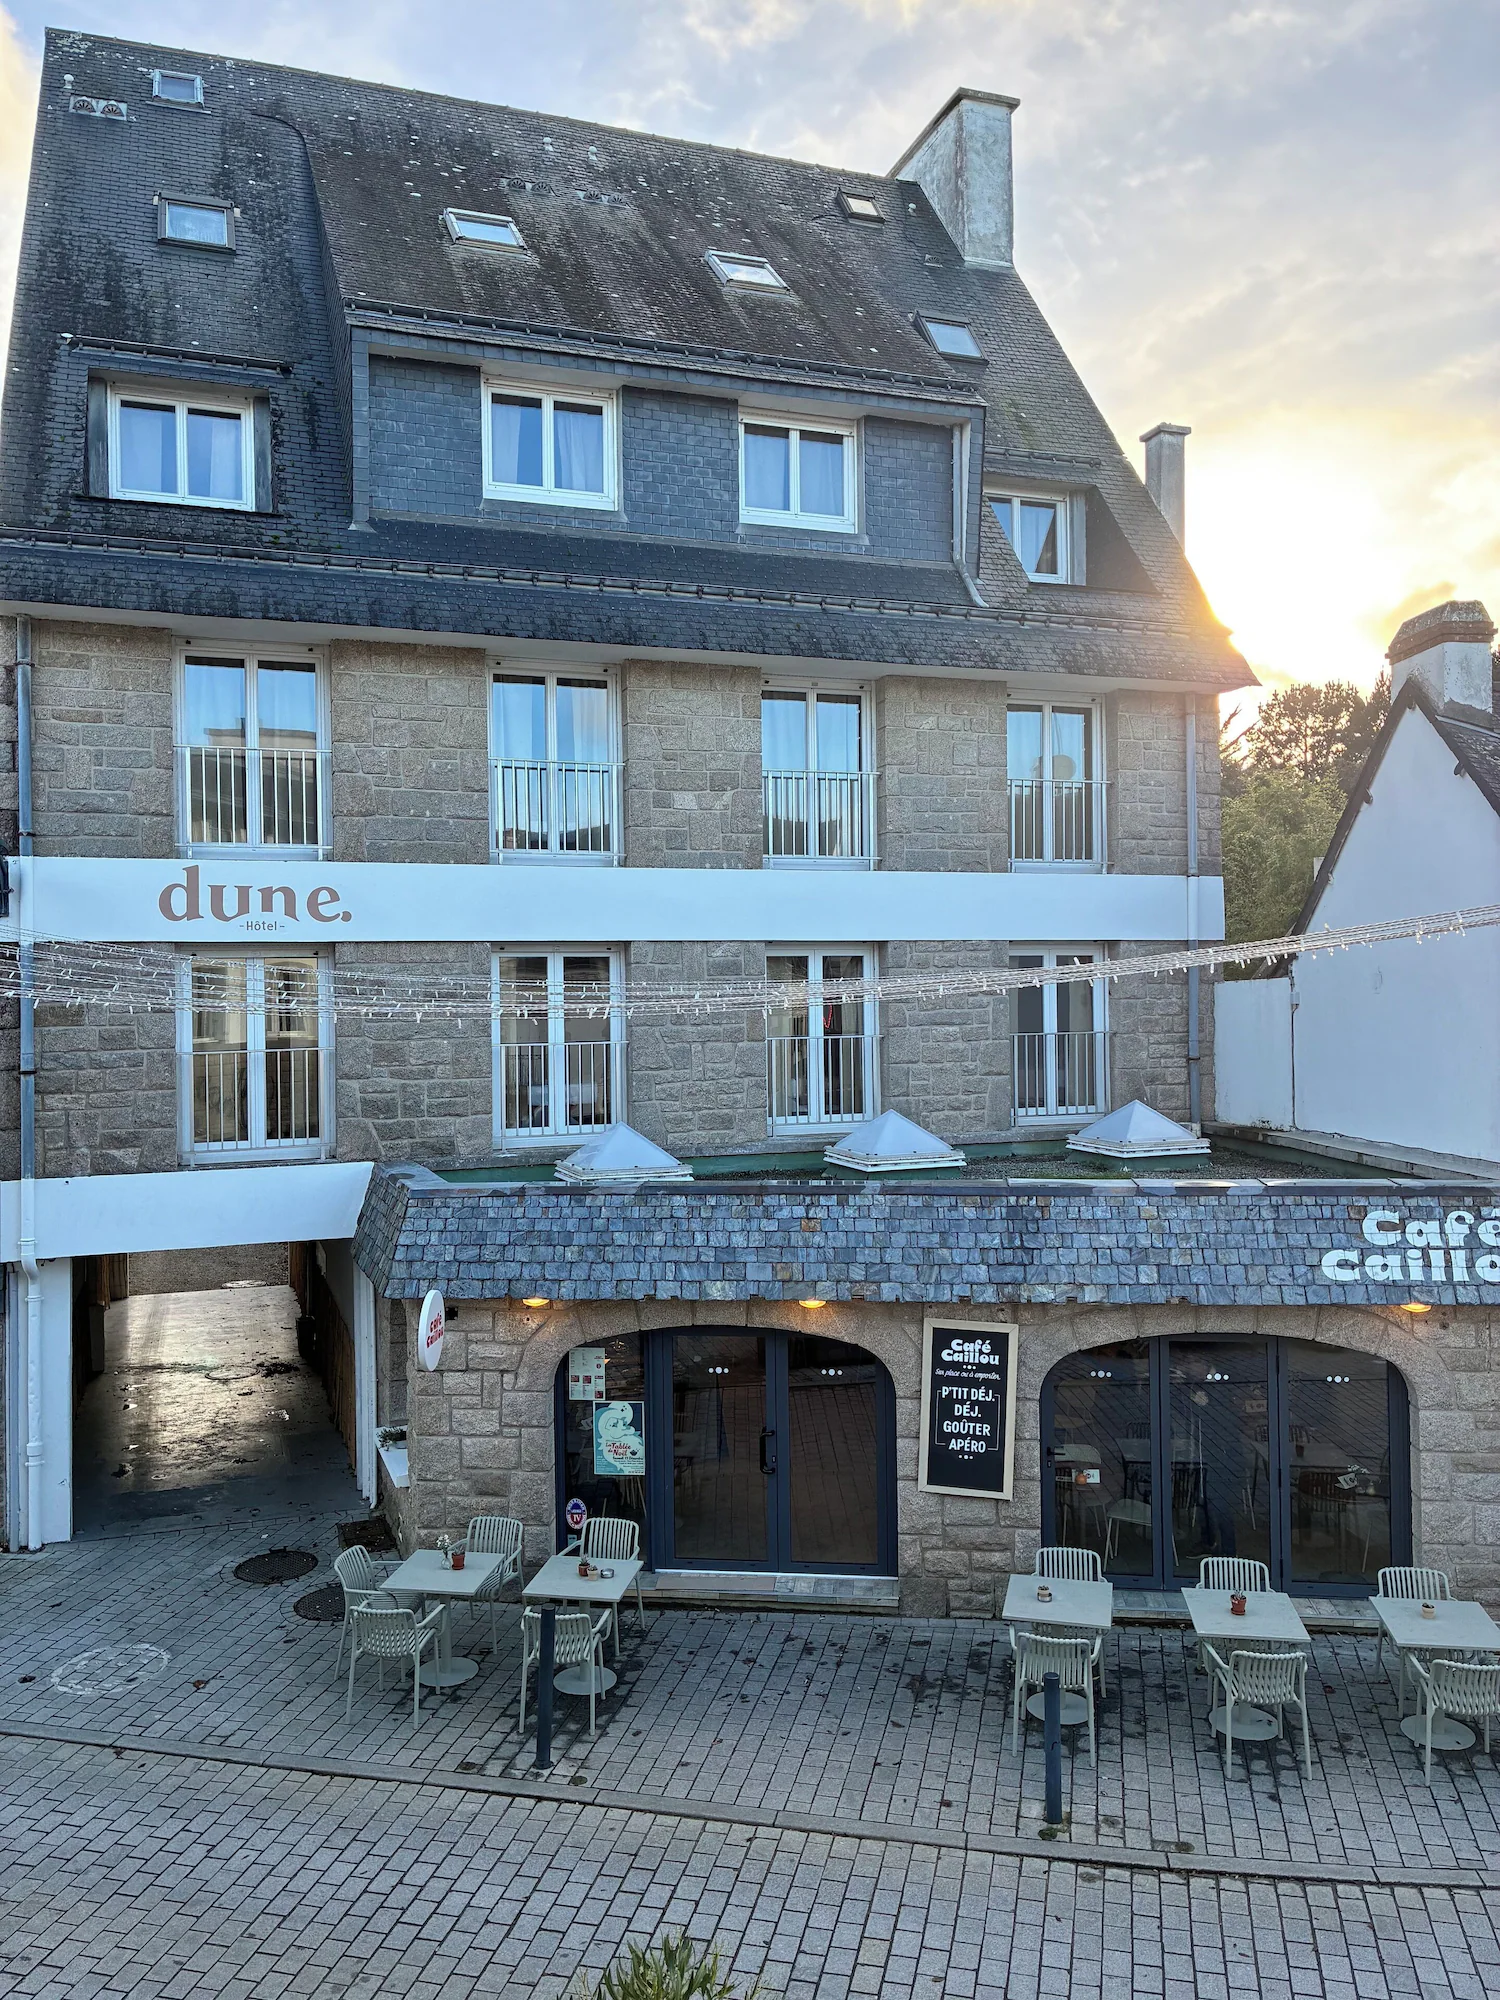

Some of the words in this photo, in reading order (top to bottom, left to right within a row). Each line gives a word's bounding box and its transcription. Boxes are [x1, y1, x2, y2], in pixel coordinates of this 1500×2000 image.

[951, 1338, 992, 1354] Café
[941, 1349, 1000, 1366] Caillou
[944, 1369, 960, 1378] place
[970, 1386, 996, 1402] DÉJ.
[954, 1401, 982, 1418] DÉJ.
[943, 1418, 991, 1437] GOÛTER
[948, 1436, 987, 1453] APÉRO
